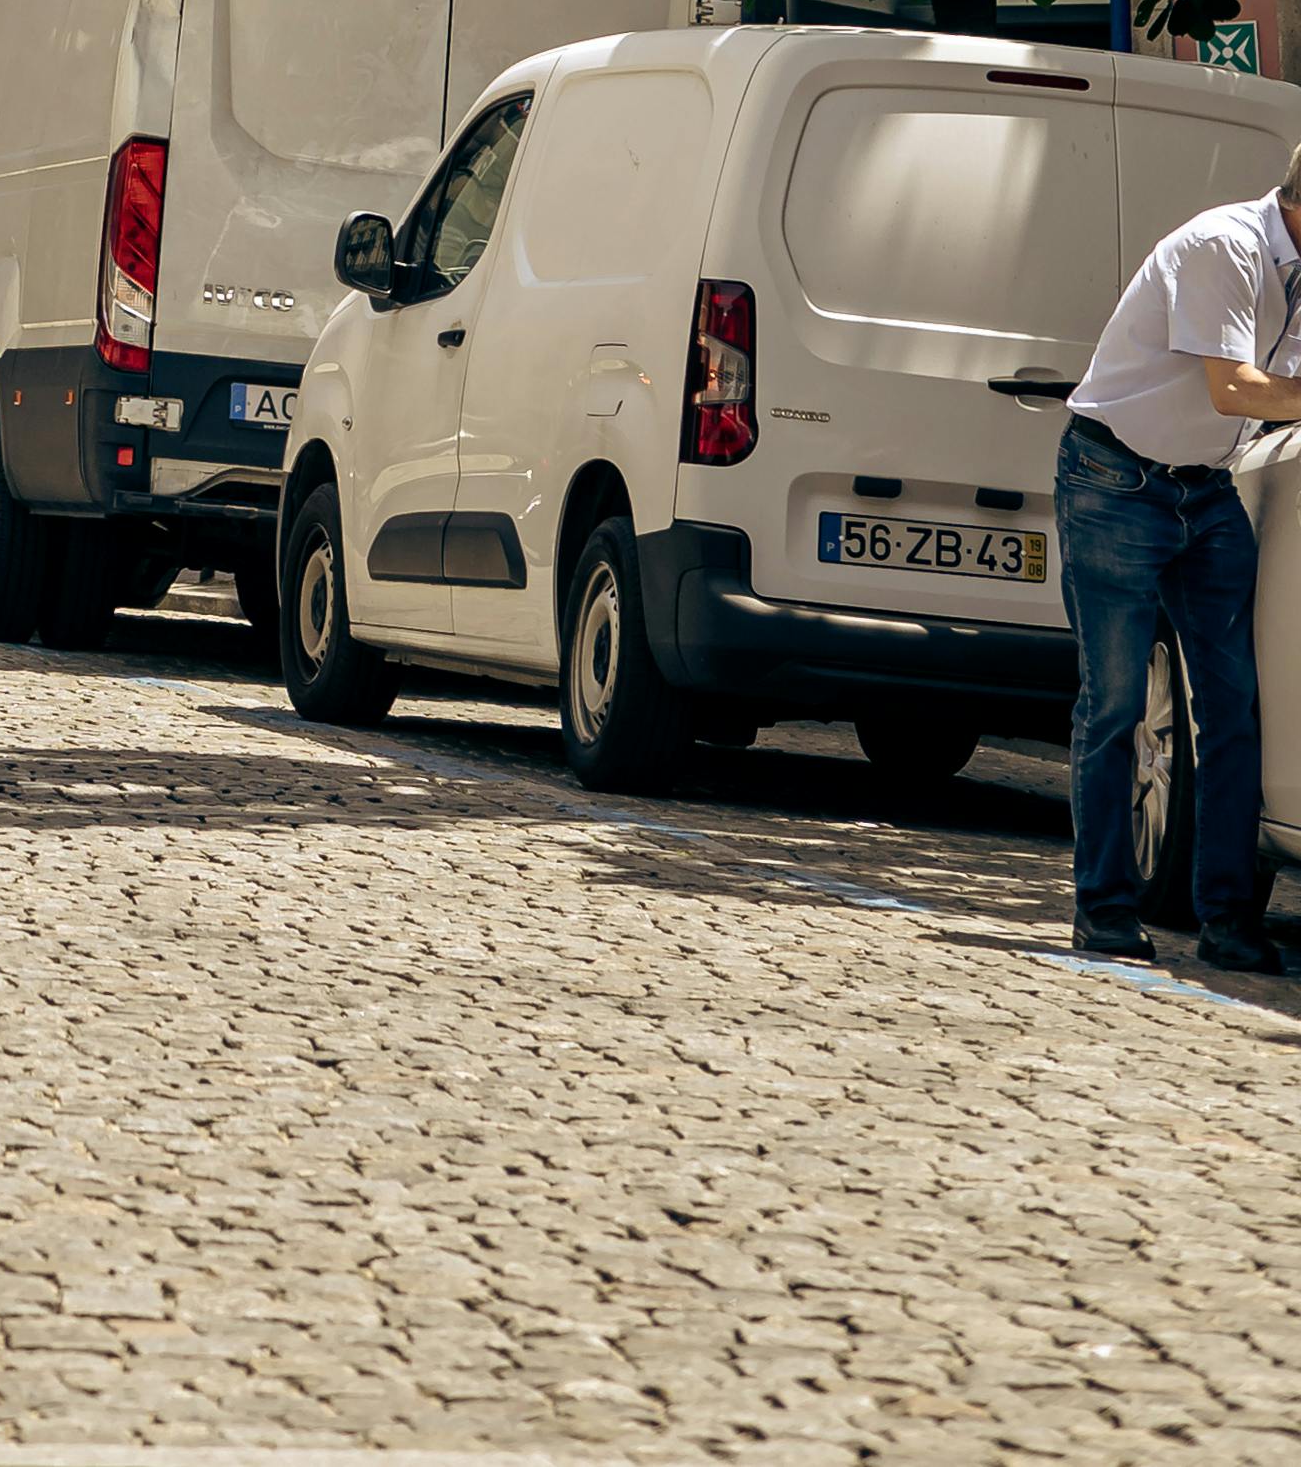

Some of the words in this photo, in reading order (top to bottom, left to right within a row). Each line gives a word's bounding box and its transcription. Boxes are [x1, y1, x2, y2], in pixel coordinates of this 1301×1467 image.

[826, 542, 835, 553] P
[1029, 539, 1041, 552] 19
[1028, 564, 1043, 577] 08
